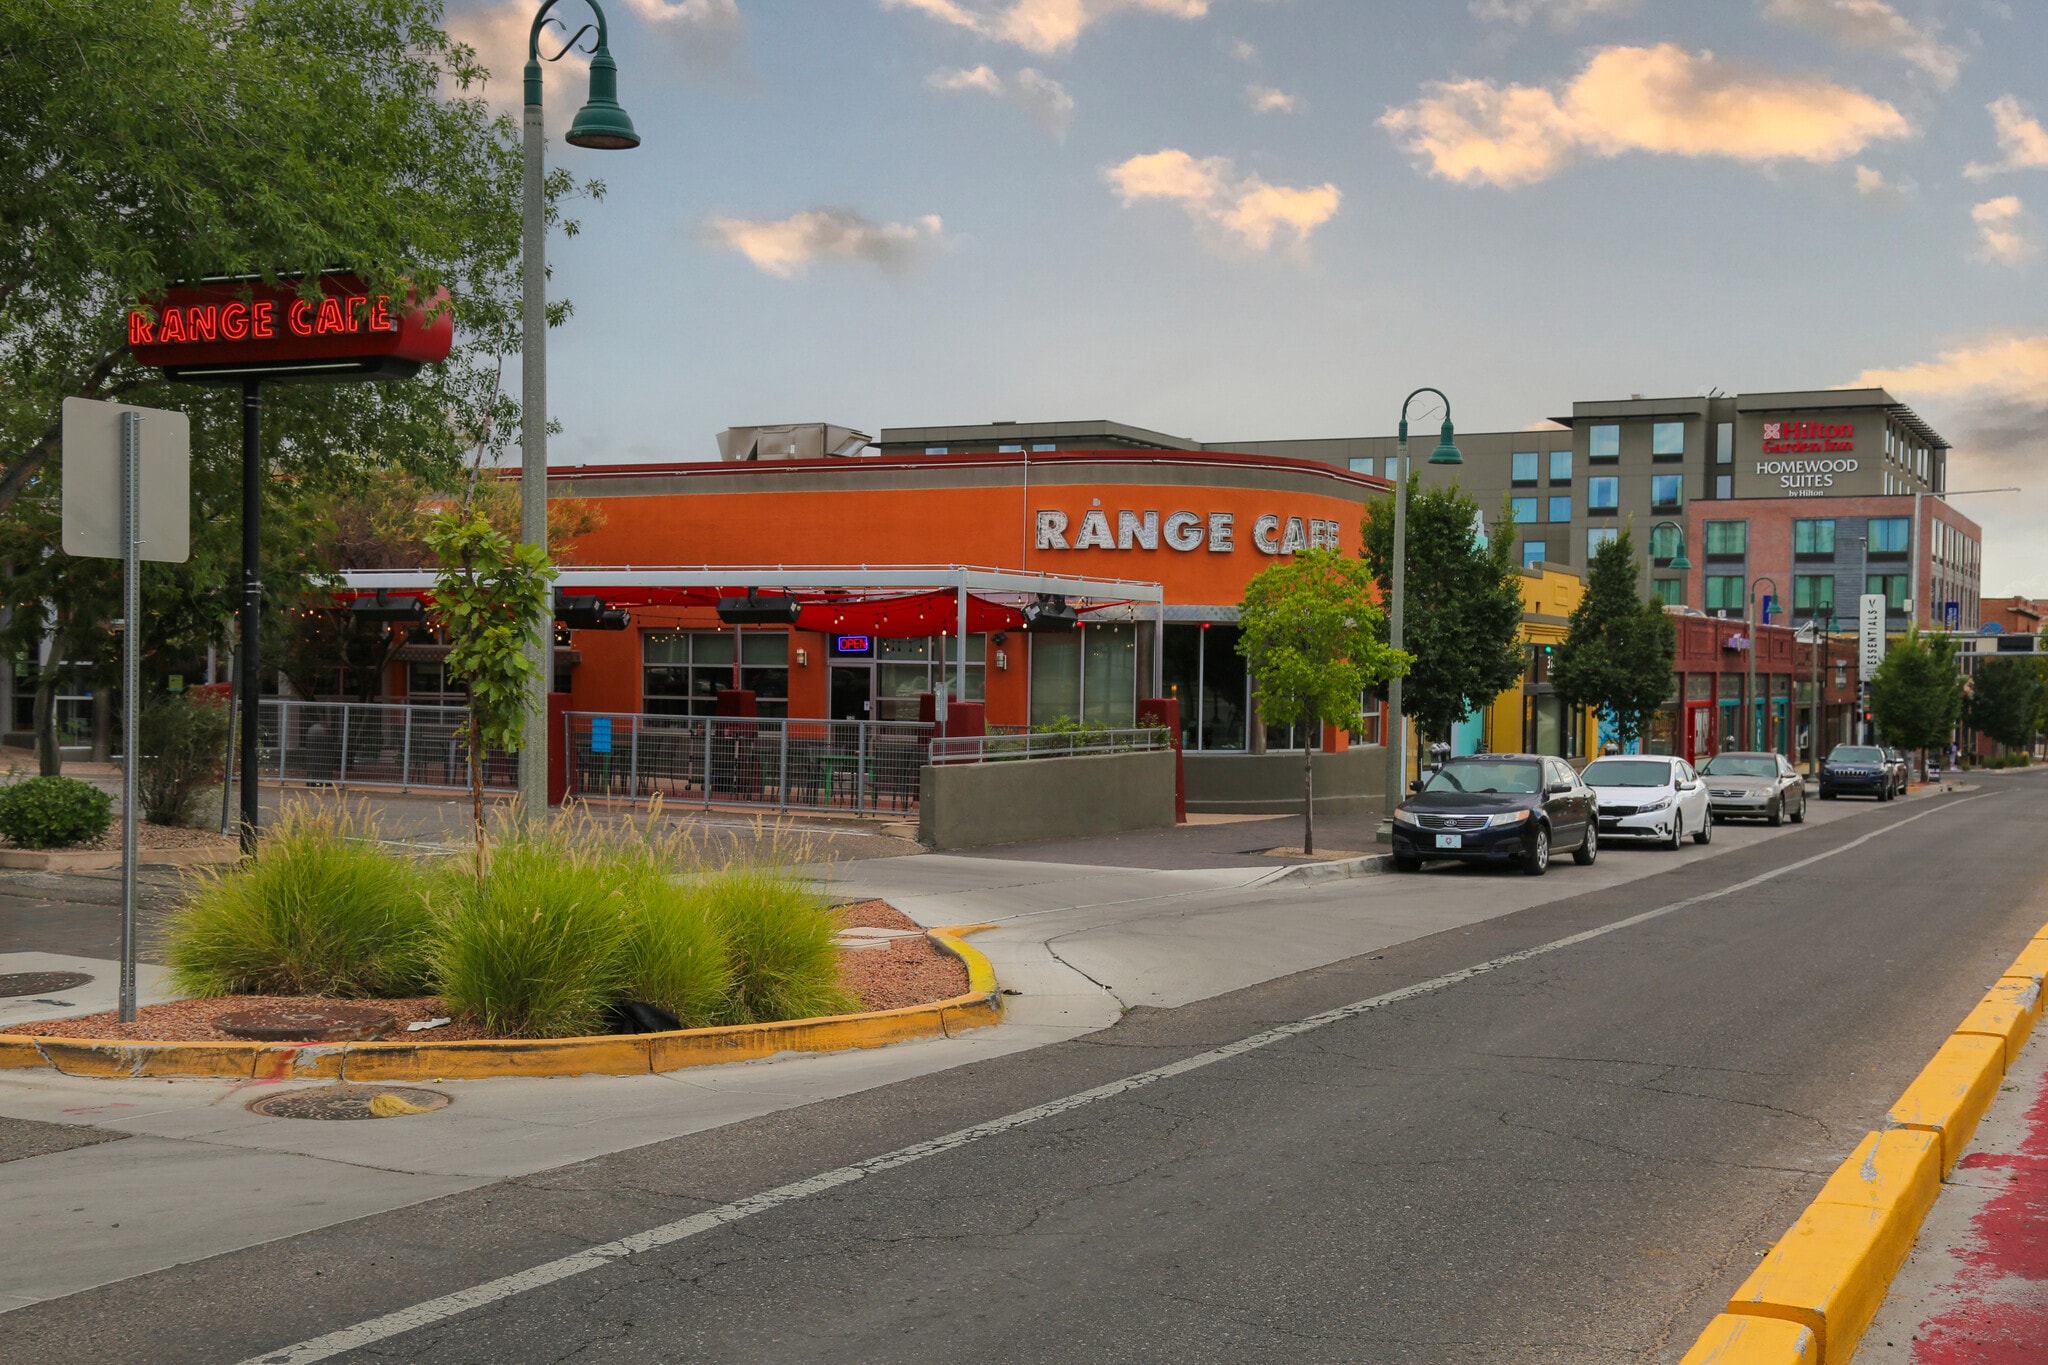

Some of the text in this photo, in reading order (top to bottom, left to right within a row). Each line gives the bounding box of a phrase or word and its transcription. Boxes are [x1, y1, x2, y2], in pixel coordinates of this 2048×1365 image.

[128, 296, 392, 345] RANGE CAFE
[1783, 421, 1854, 439] Hilton
[1763, 440, 1853, 454] Garden Inn
[1757, 459, 1858, 474] HOMEWOOD
[1781, 474, 1833, 488] SUITES
[1035, 509, 1234, 552] RANGE
[841, 639, 867, 649] OPEN
[1867, 610, 1877, 665] ESSENTIALS
